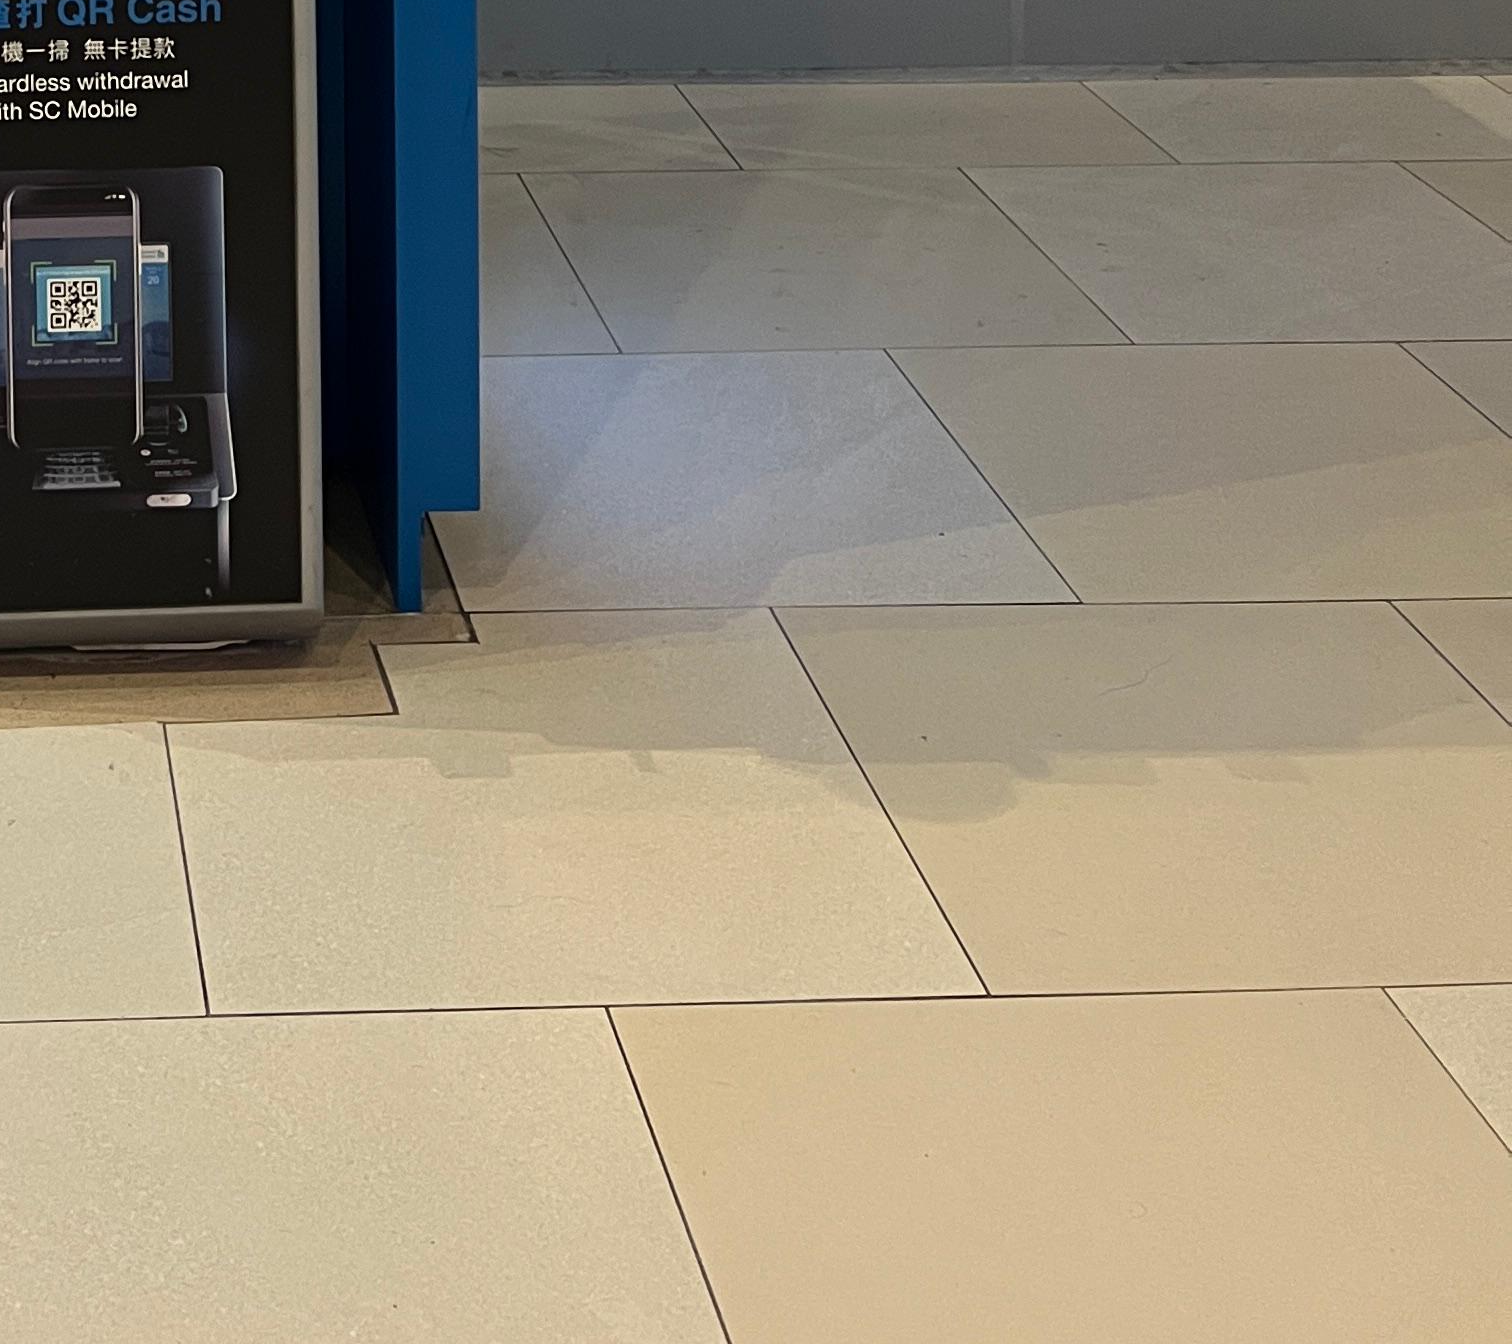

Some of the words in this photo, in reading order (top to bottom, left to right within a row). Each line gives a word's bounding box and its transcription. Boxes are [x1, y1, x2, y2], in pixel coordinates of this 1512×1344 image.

[83, 36, 176, 61] 無卡提款
[77, 69, 189, 92] withdrawal
[28, 100, 61, 120] SC
[67, 98, 138, 119] Mobile
